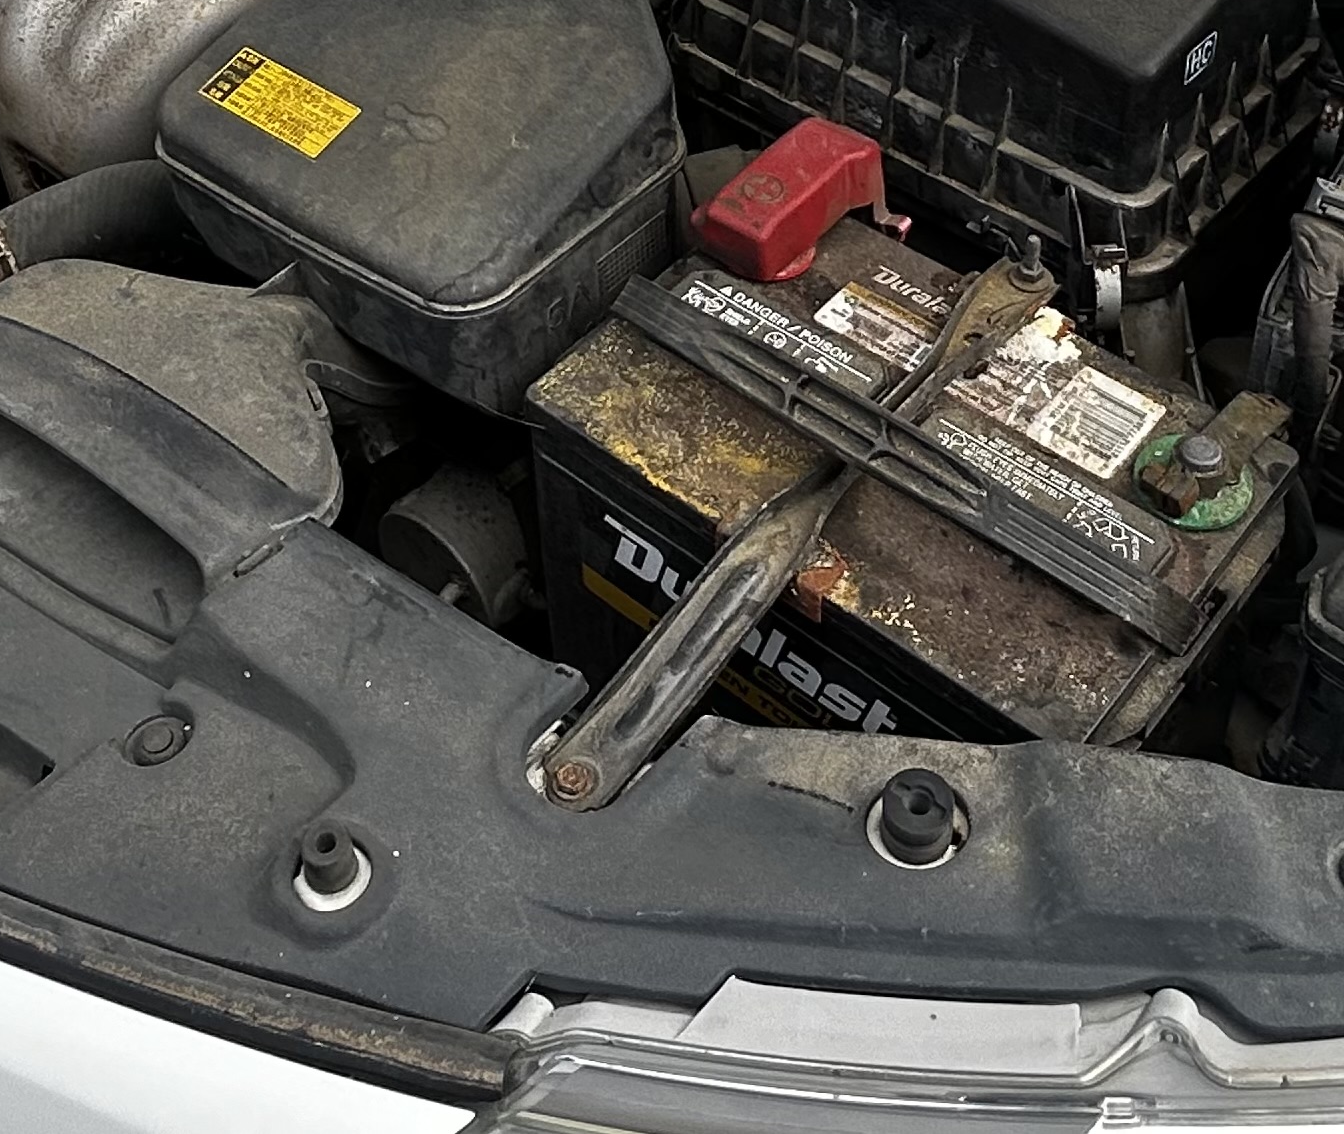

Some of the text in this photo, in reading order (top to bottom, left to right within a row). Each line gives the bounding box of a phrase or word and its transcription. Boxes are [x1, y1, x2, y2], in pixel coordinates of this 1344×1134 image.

[871, 264, 953, 315] Durala
[733, 291, 791, 332] DANGER
[798, 326, 854, 365] POISON
